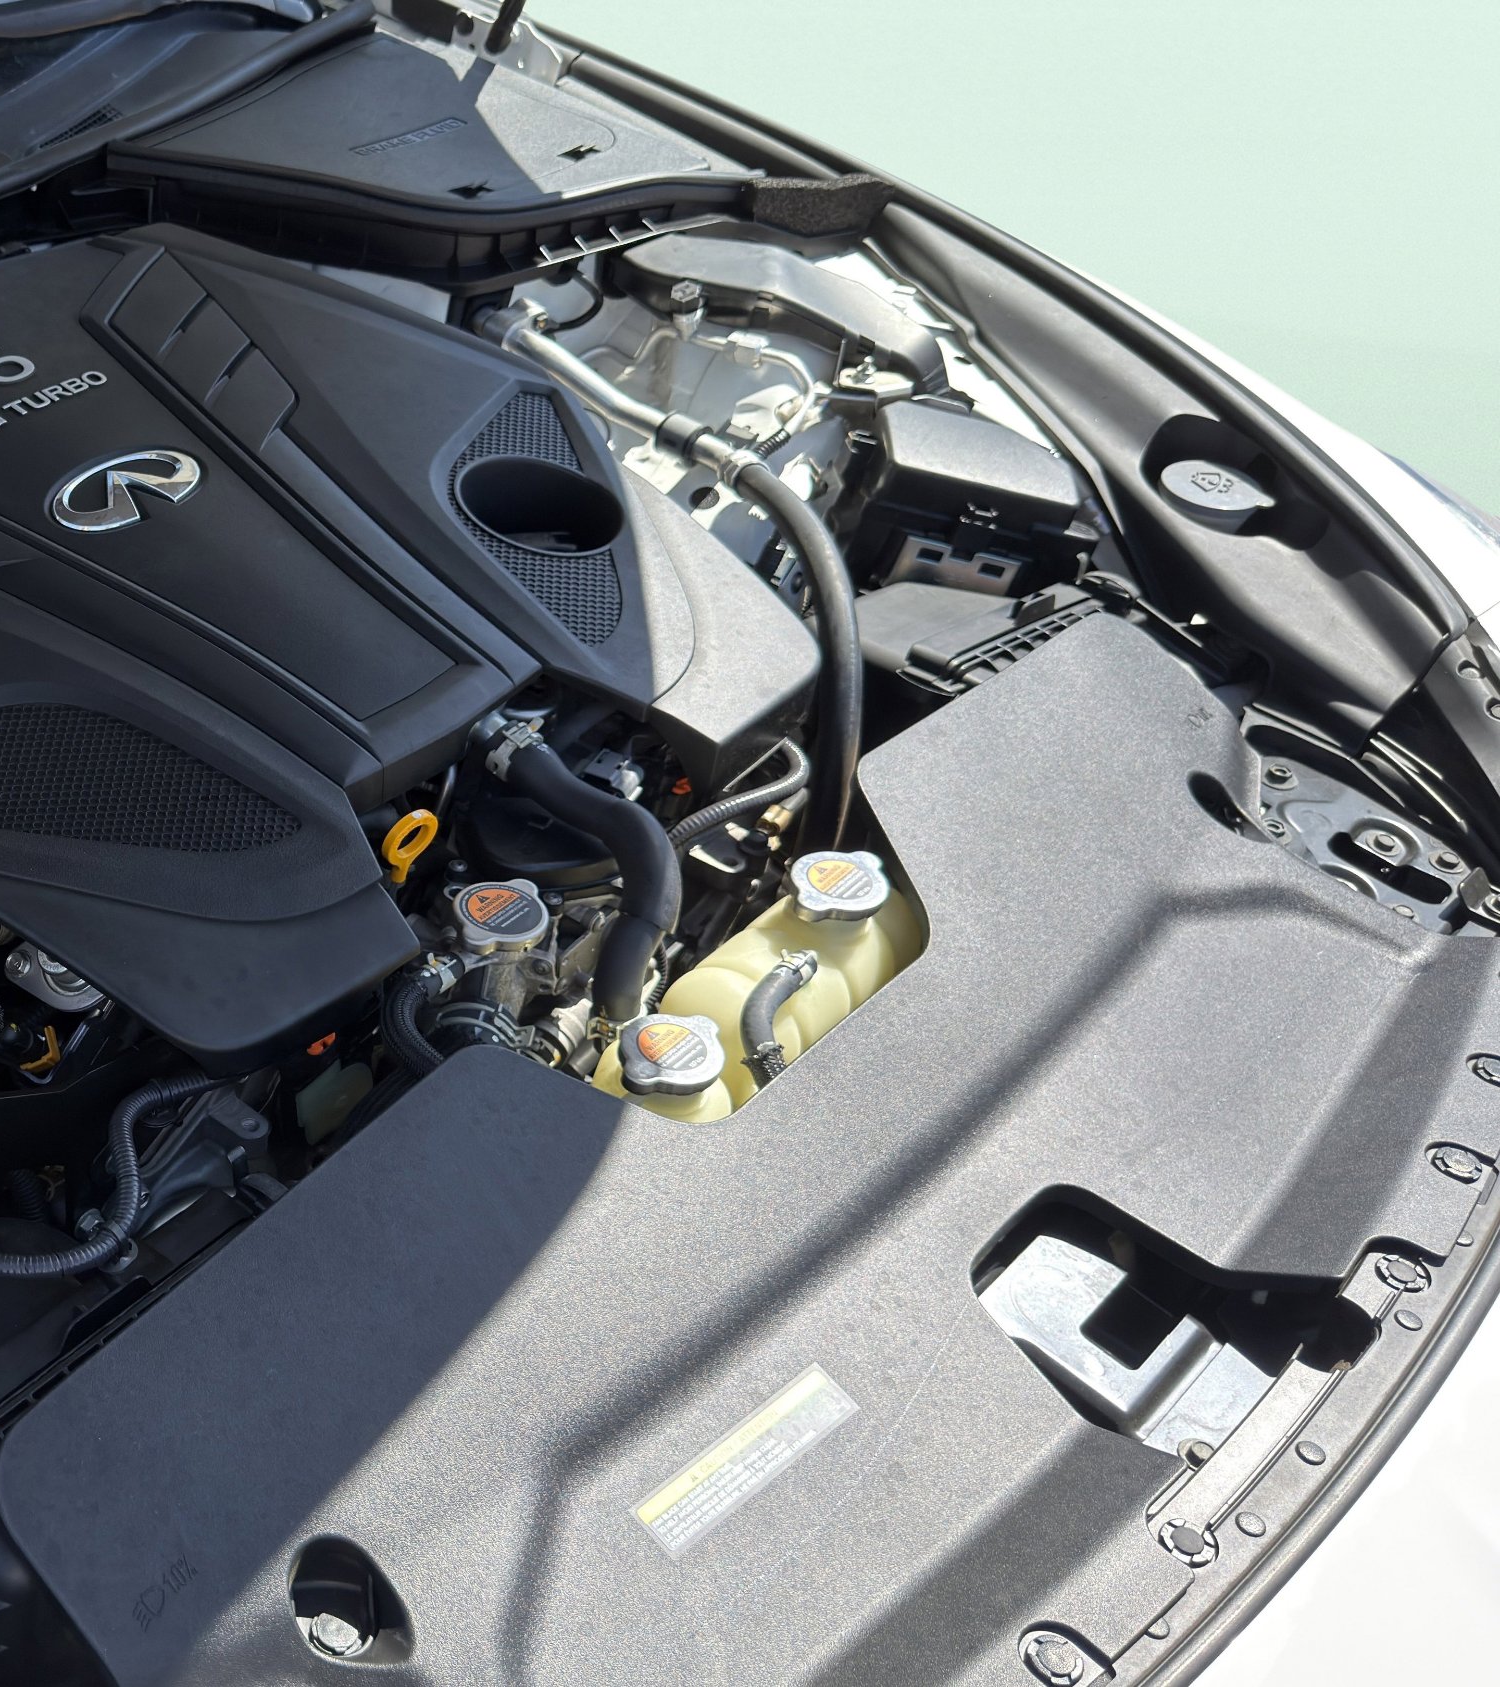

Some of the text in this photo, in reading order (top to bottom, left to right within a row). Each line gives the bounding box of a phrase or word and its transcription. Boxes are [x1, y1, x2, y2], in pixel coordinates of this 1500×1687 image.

[354, 119, 461, 157] BRAKE FLUID
[2, 370, 108, 416] TURBO
[475, 893, 505, 913] WARNING
[647, 1029, 675, 1051] WARNING
